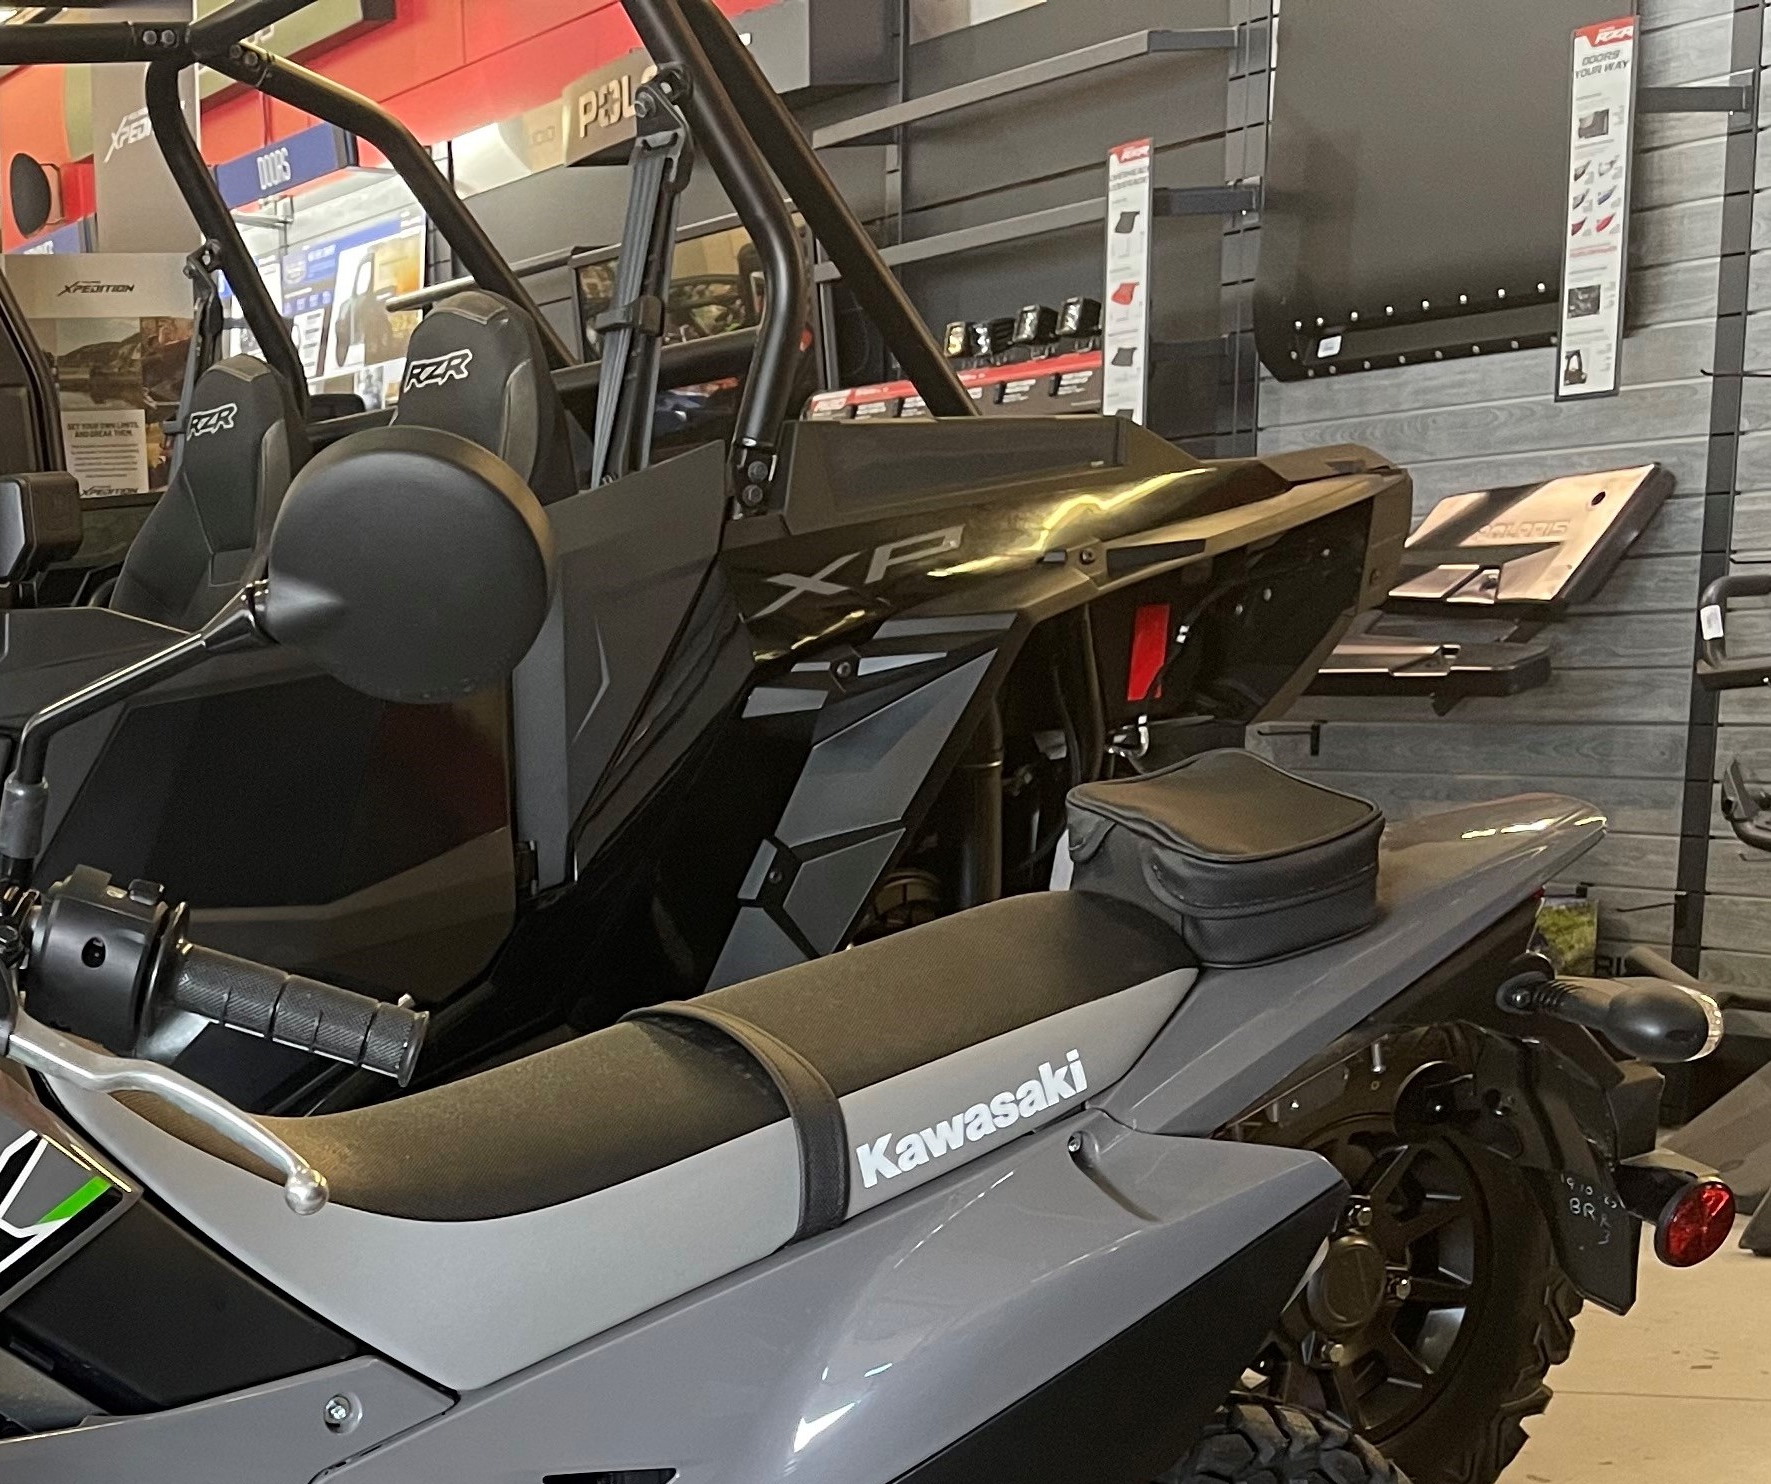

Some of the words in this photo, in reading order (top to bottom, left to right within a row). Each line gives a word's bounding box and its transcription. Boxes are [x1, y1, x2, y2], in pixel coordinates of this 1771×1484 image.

[1604, 60, 1629, 72] WAY
[57, 280, 135, 297] XPEDITION
[403, 348, 473, 393] RZR
[186, 402, 238, 442] RZR
[747, 524, 966, 620] XP
[856, 1048, 1088, 1188] Kawasaki
